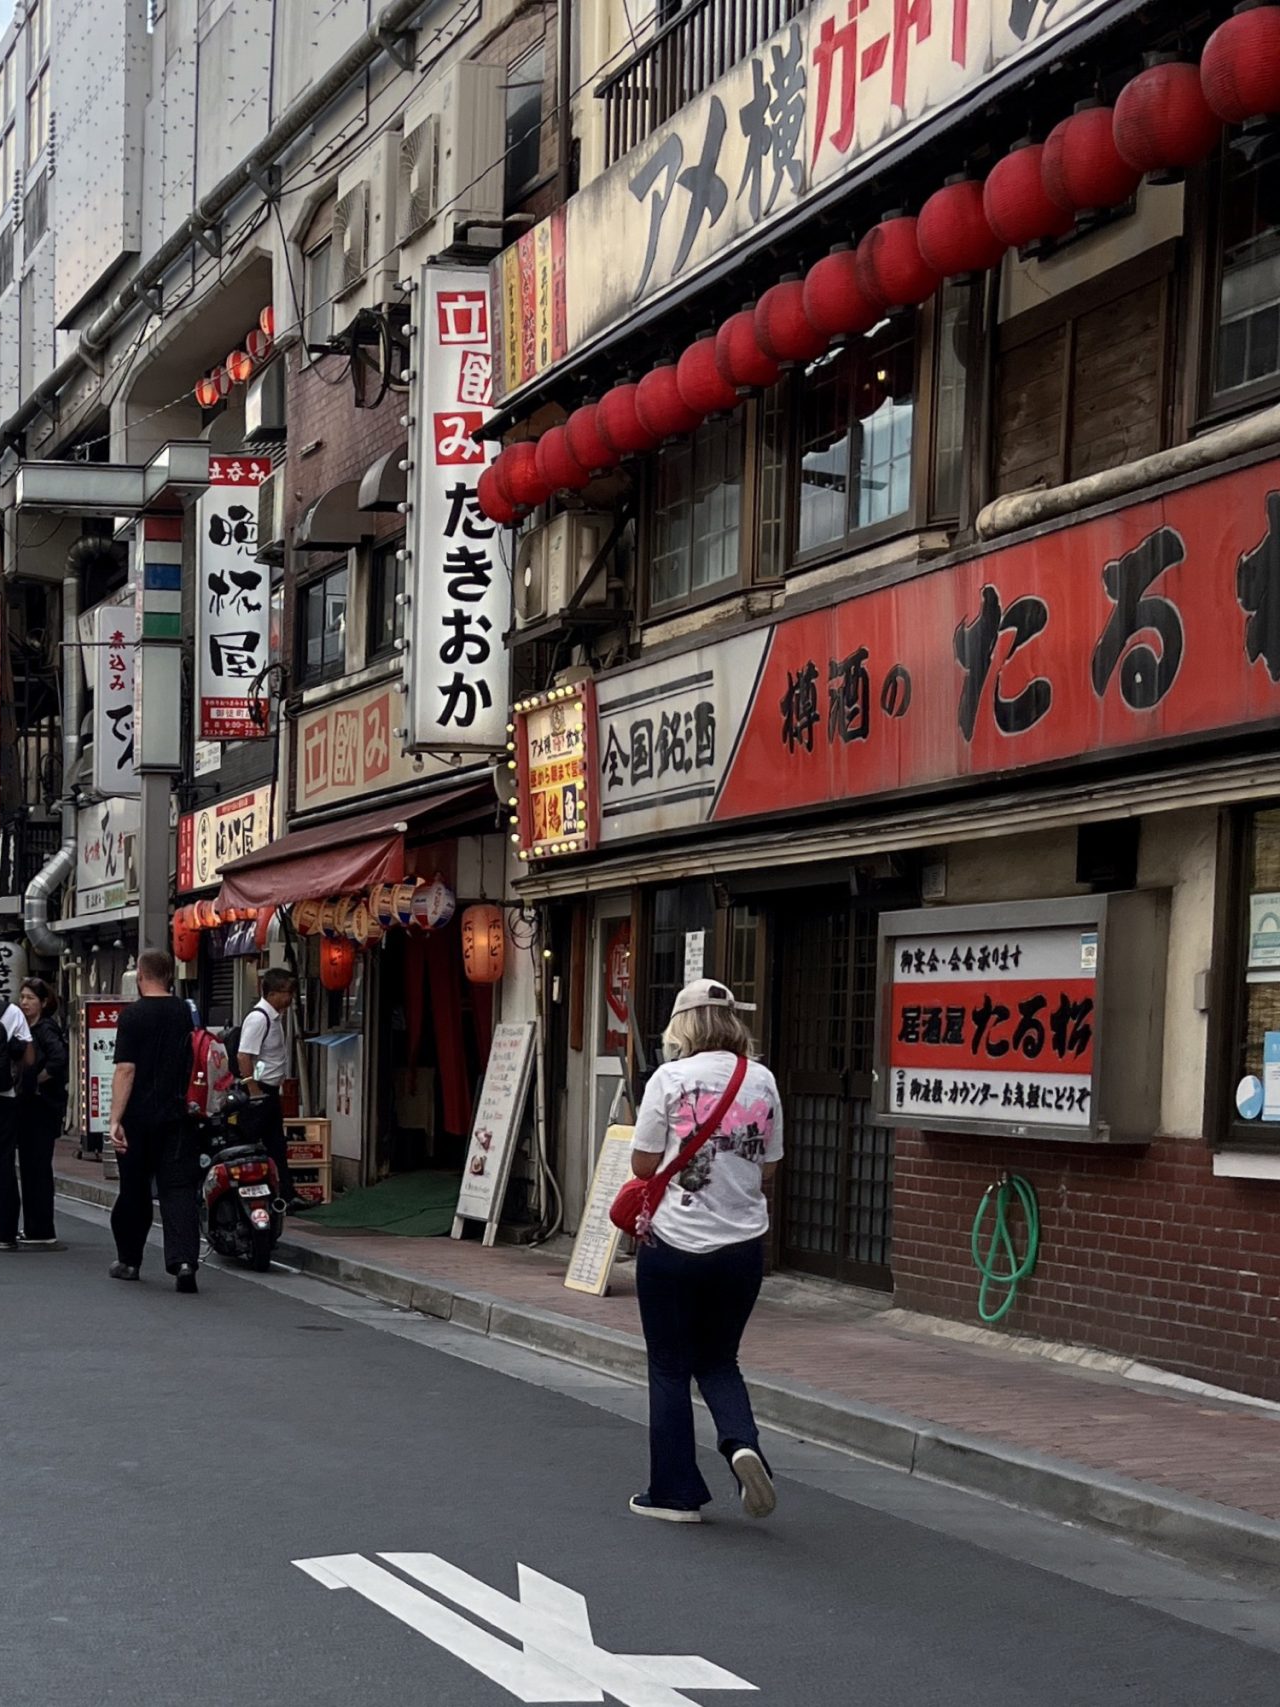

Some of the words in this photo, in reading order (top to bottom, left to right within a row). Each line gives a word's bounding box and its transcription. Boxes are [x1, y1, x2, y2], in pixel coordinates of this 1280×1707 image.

[207, 504, 263, 678] 晩杯屋
[437, 482, 494, 728] たきおか
[108, 629, 127, 691] 煮込み
[778, 645, 913, 755] 樽酒の
[304, 693, 390, 799] 立飲み
[600, 701, 717, 789] 全国銘酒
[897, 1004, 966, 1045] 居酒屋
[971, 991, 1095, 1061] たる松
